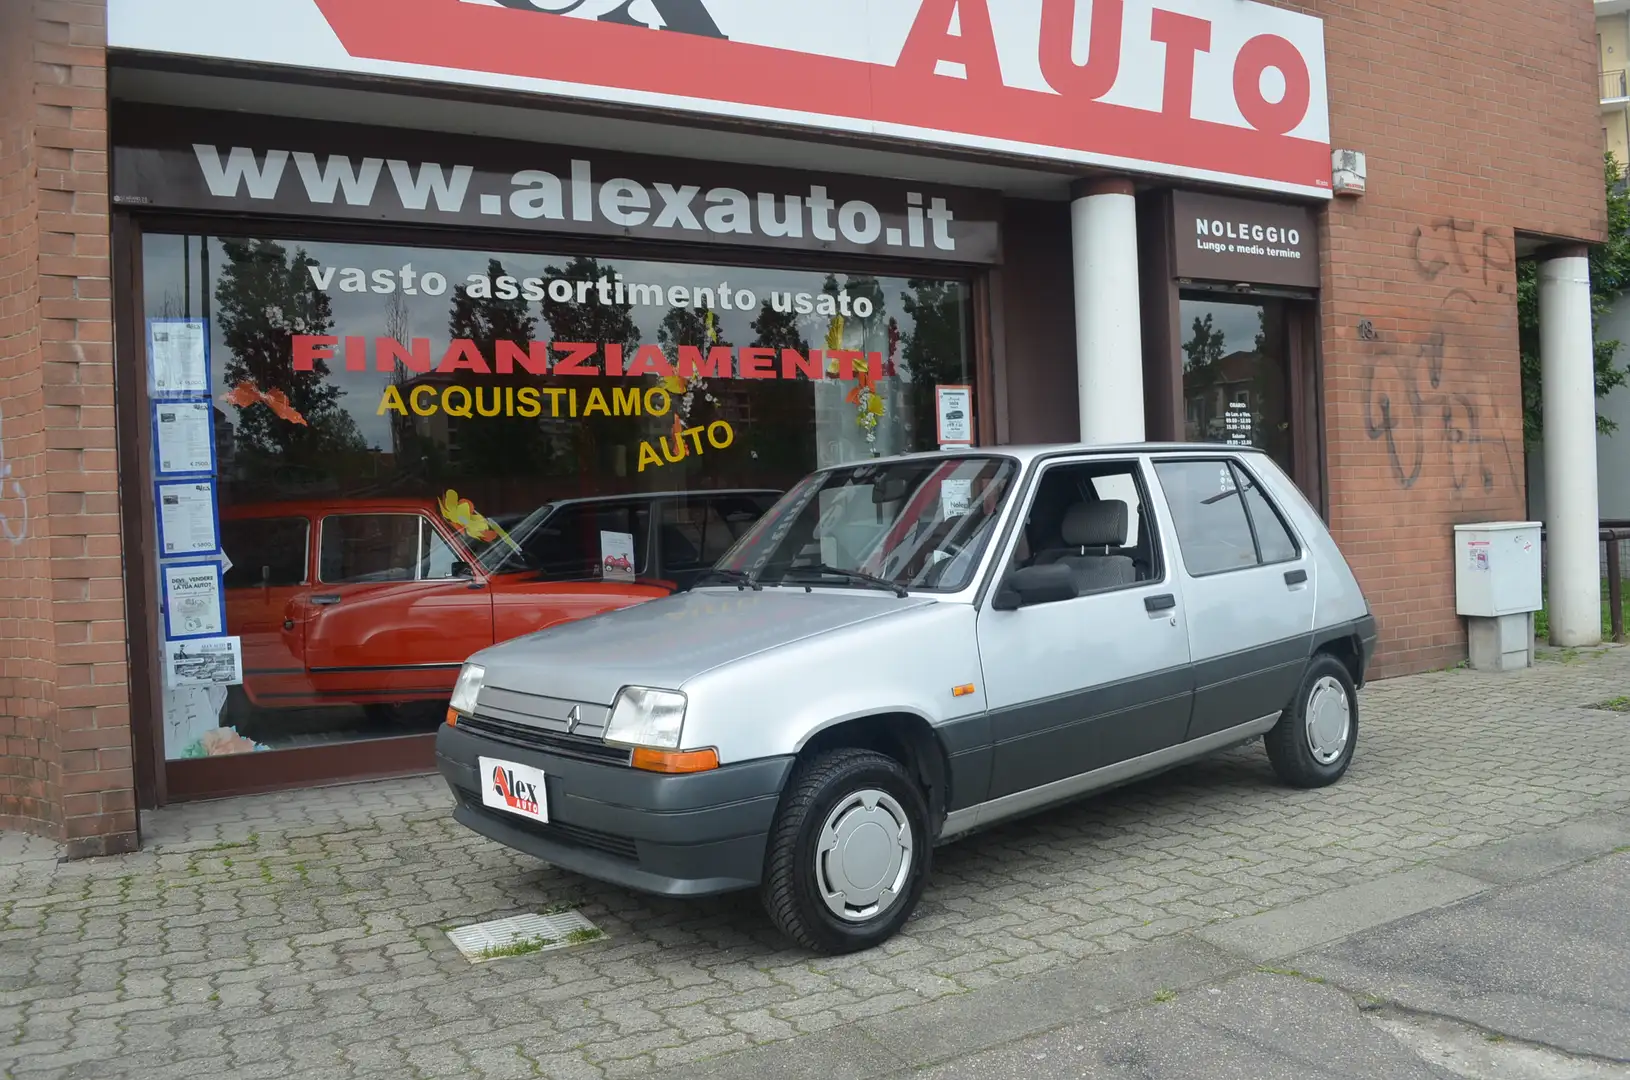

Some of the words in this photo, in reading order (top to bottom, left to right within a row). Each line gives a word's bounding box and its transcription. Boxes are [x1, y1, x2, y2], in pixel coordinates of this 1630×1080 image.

[894, 0, 1310, 136] AUTO
[192, 143, 955, 250] www.alexauto.it
[1196, 218, 1299, 244] NOLEGGIO
[1197, 238, 1226, 253] Lungo
[1228, 244, 1235, 252] e
[1236, 244, 1265, 255] medio
[1266, 247, 1301, 259] termine
[307, 263, 447, 296] vasto
[466, 273, 756, 312] assortimento
[771, 287, 873, 317] usato
[292, 335, 882, 381] FINANZIAMENTI
[376, 385, 671, 419] ACQUISTIAMO
[637, 420, 734, 472] AUTO
[493, 765, 538, 805] Alex
[516, 798, 538, 814] AUTO
